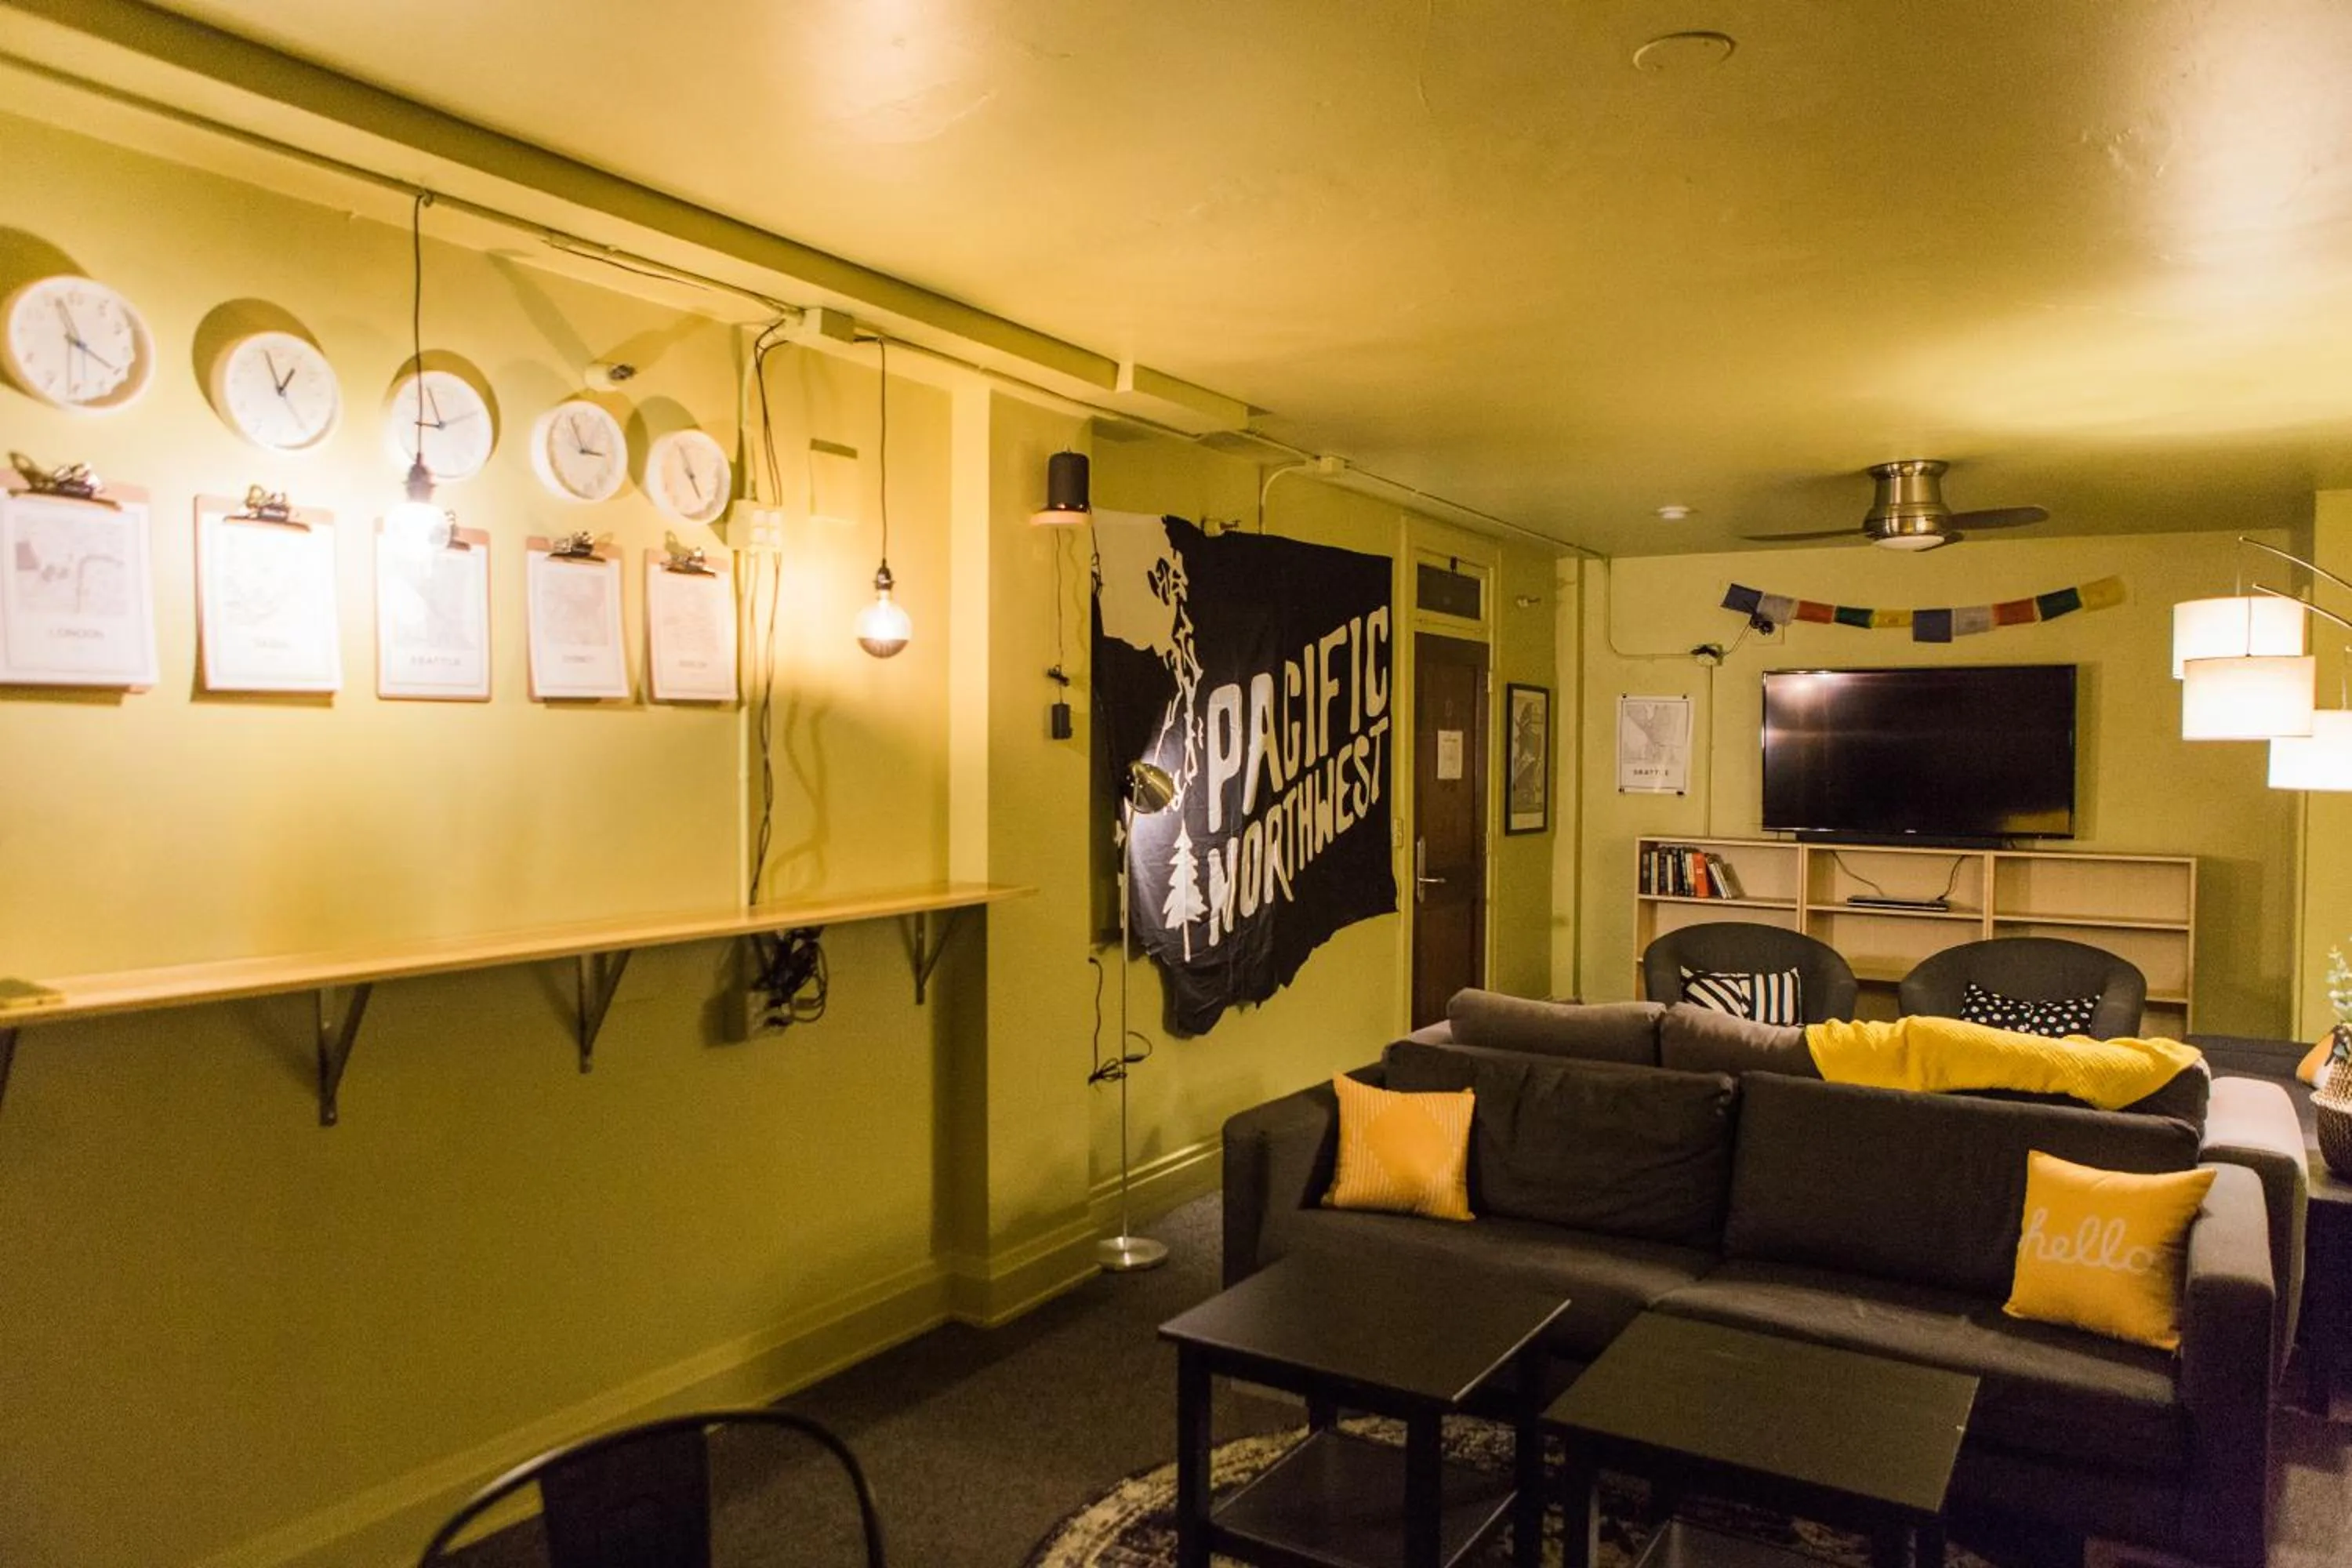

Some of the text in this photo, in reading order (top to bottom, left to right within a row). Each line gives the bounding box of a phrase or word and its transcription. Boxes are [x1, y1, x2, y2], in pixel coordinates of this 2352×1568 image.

[1207, 605, 1388, 833] PACIFIC
[1207, 717, 1388, 946] NORTHWEST
[2017, 1207, 2161, 1276] hello
